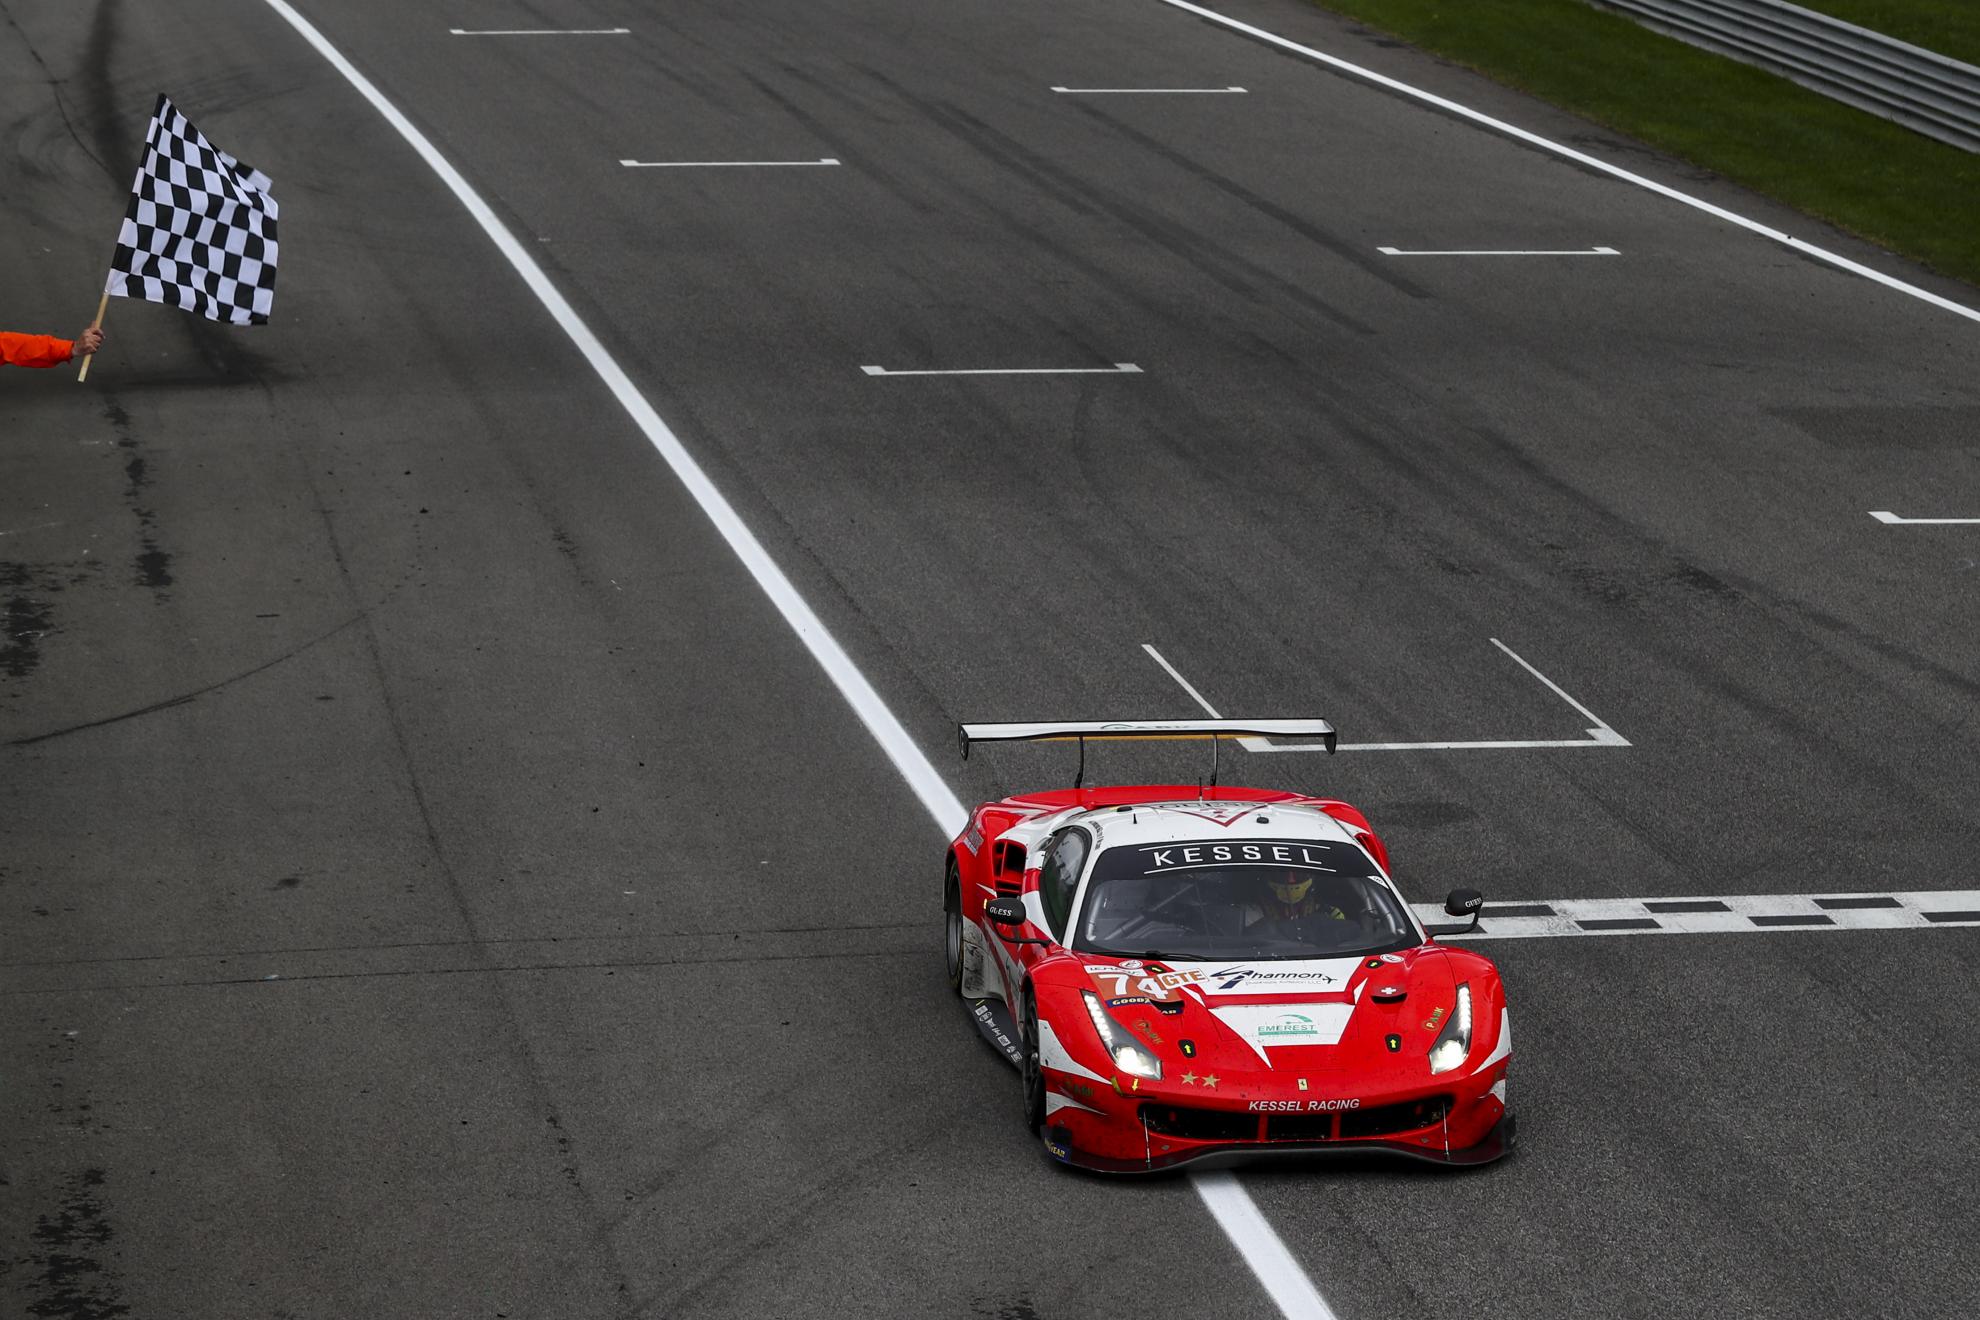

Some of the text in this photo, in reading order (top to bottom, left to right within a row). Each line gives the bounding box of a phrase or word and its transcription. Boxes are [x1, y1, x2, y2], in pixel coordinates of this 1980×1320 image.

[1153, 845, 1322, 867] KESSEL
[989, 906, 1013, 917] GUESS
[1097, 974, 1169, 1000] 74
[1161, 970, 1206, 987] GTE
[1111, 997, 1177, 1015] GOODYAR
[1248, 1098, 1360, 1112] KESSEL RACING
